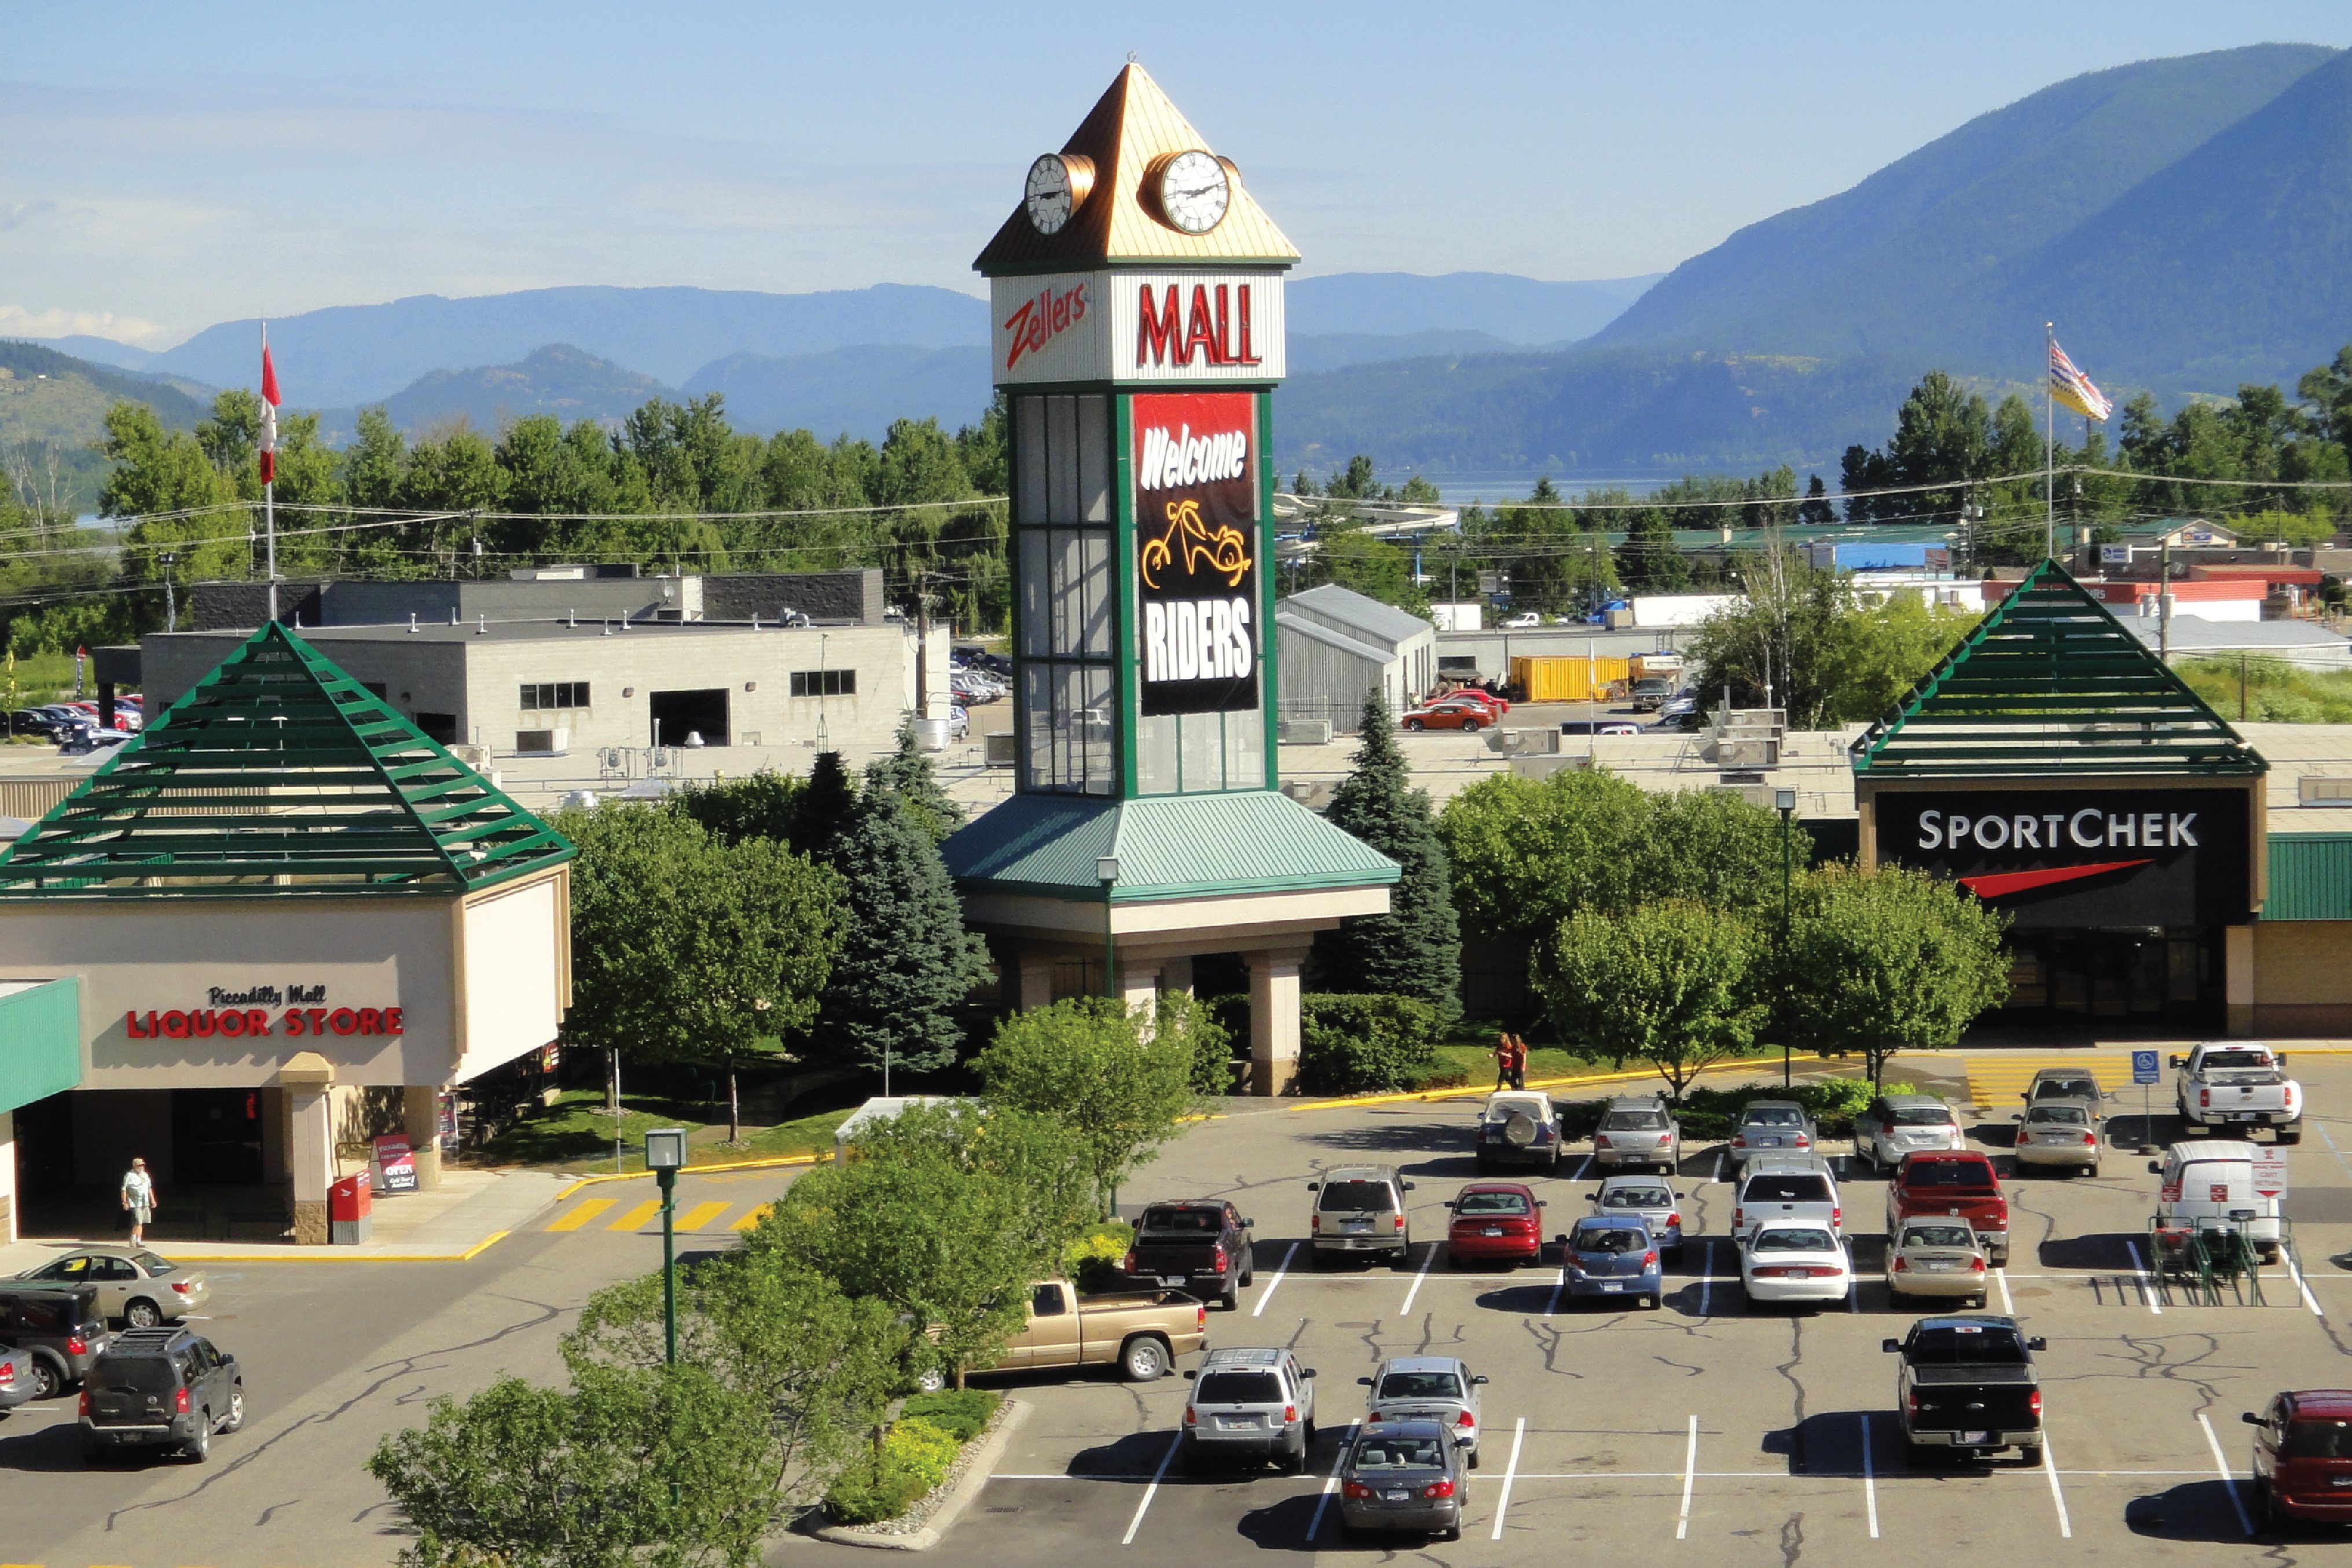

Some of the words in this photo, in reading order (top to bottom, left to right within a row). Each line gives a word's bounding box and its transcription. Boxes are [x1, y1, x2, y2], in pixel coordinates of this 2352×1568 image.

[1004, 282, 1086, 371] Zellers
[1136, 282, 1263, 368] MALL
[1140, 424, 1246, 491] Welcome
[1146, 597, 1251, 682] RIDERS
[126, 1009, 271, 1038] LIQUOR
[284, 1007, 404, 1036] STORE
[208, 986, 282, 1006] Piccadilly
[289, 985, 326, 1003] Mall
[386, 1165, 413, 1176] OPEN
